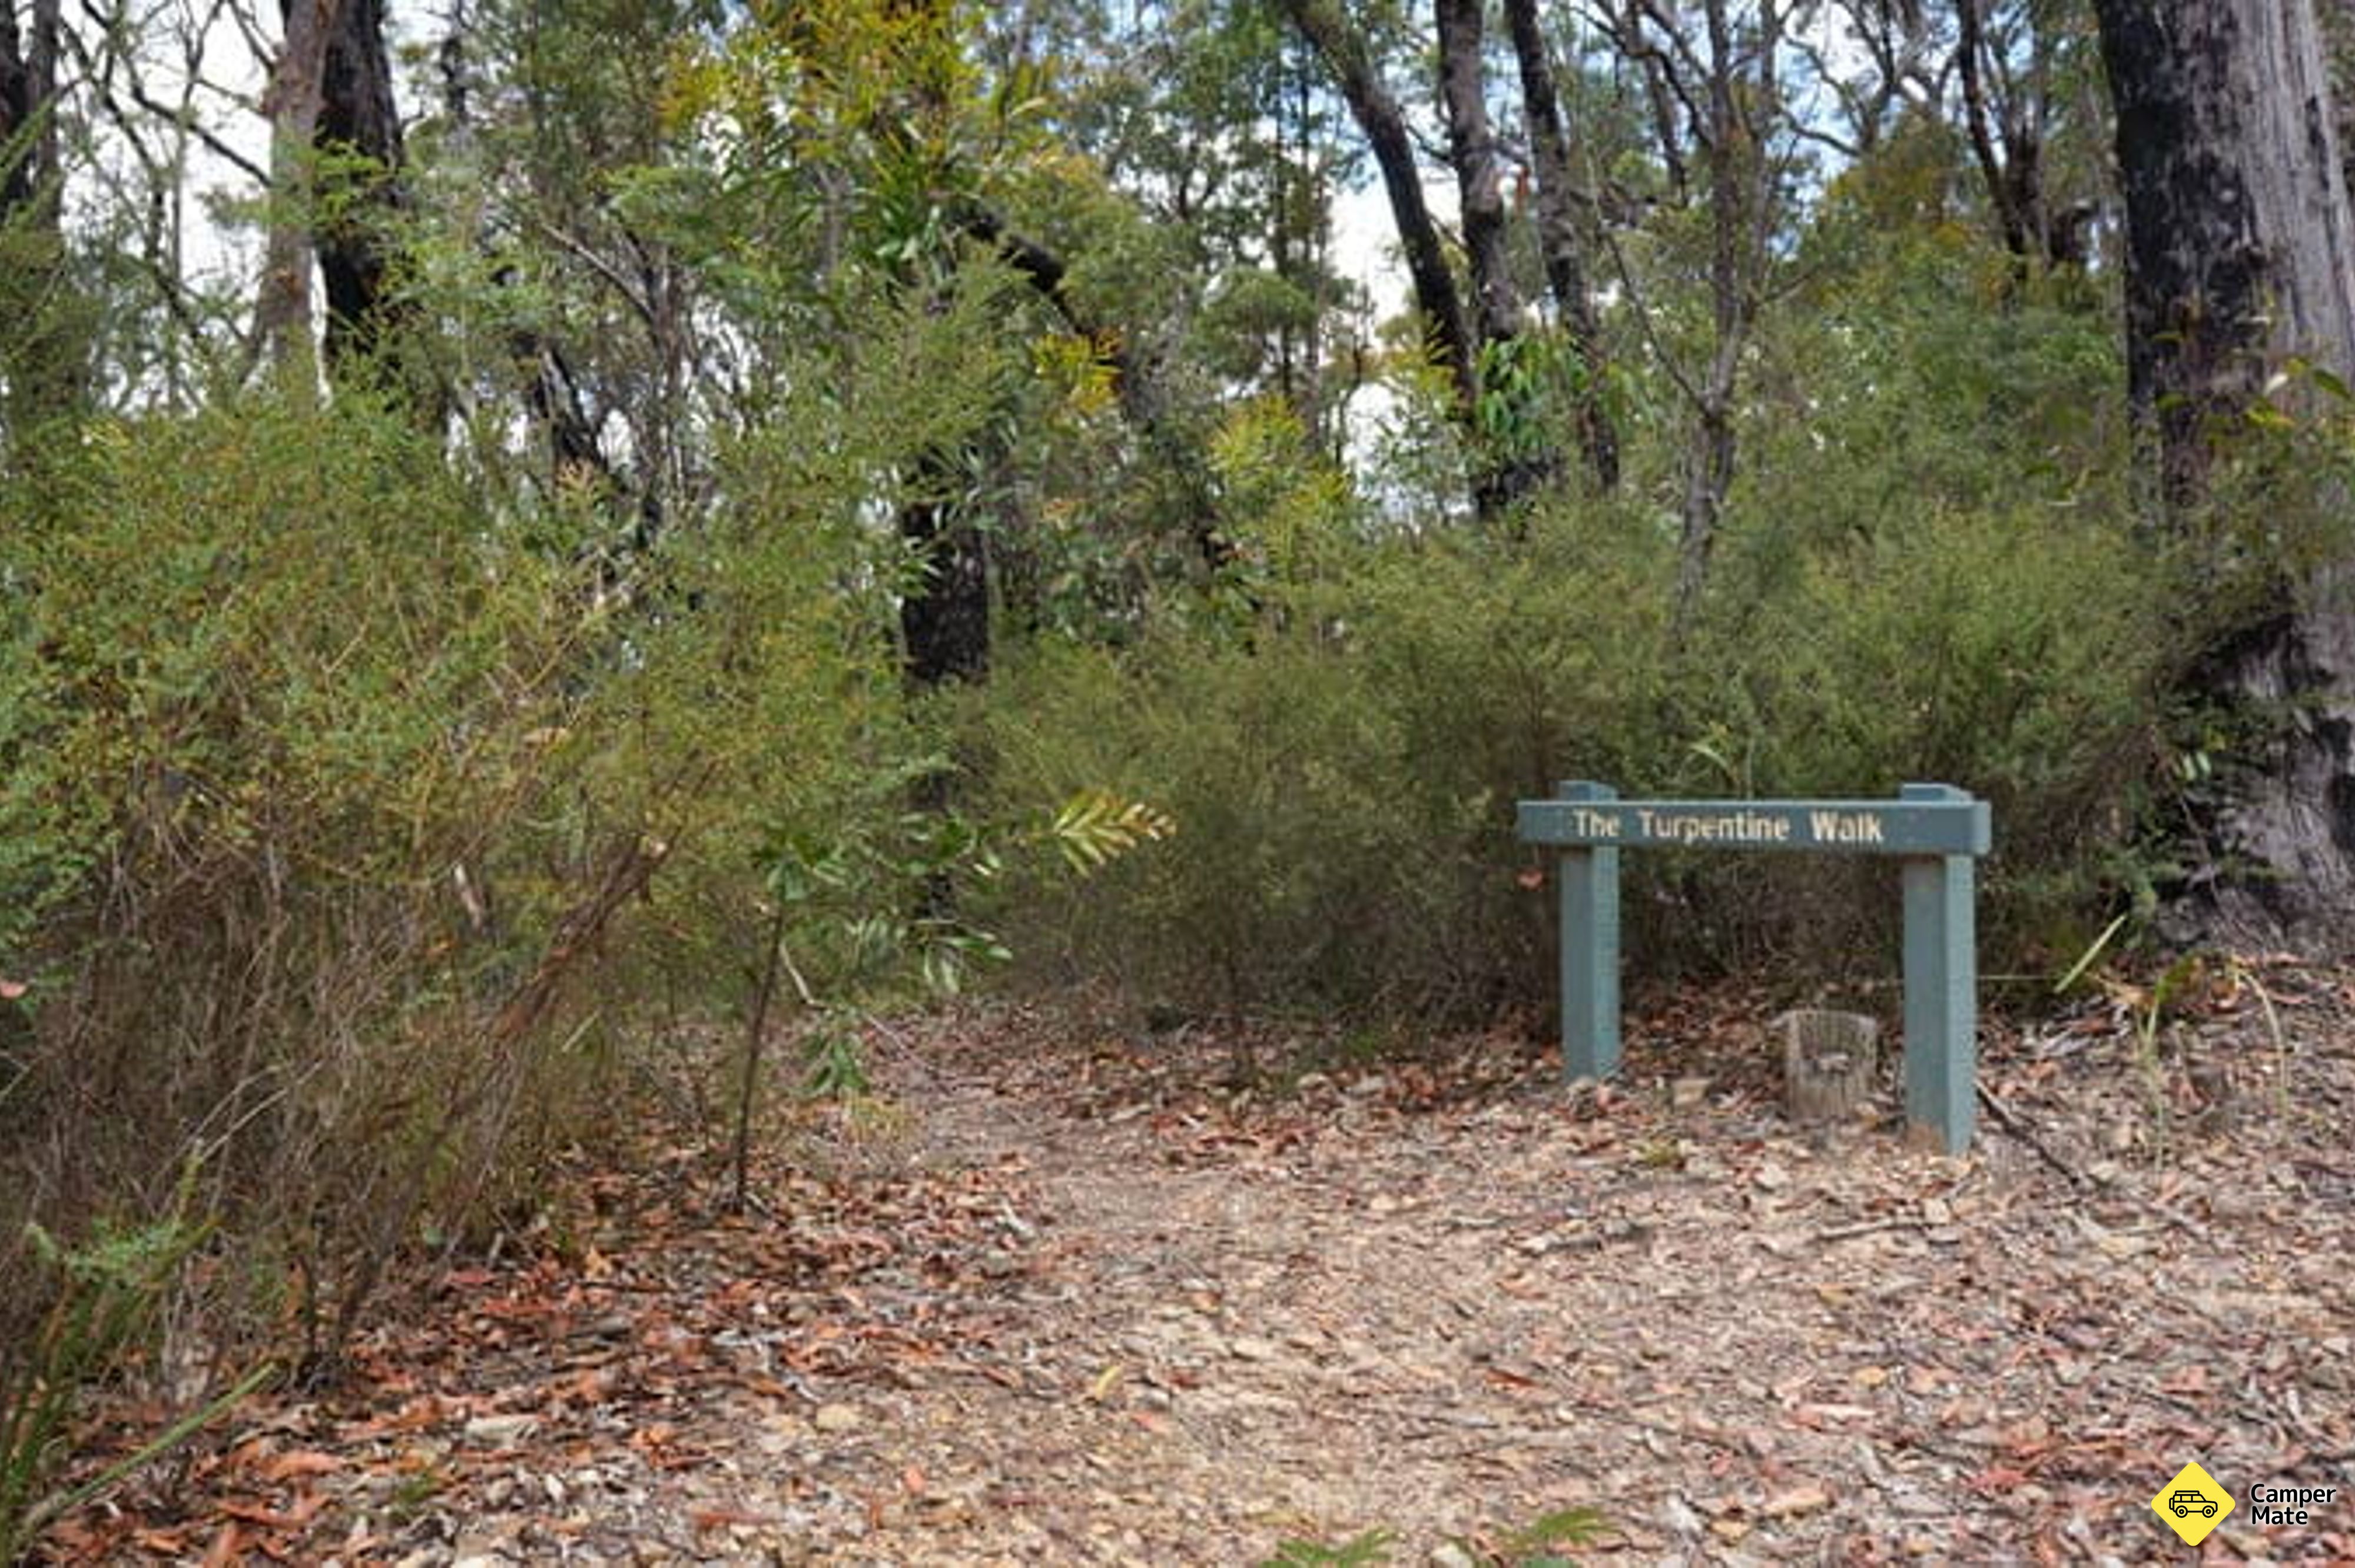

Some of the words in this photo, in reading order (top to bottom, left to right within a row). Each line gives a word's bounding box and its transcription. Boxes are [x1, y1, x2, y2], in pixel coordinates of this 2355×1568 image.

[1573, 810, 1620, 838] The
[1637, 810, 1790, 844] Turpentine
[1810, 812, 1883, 842] Walk
